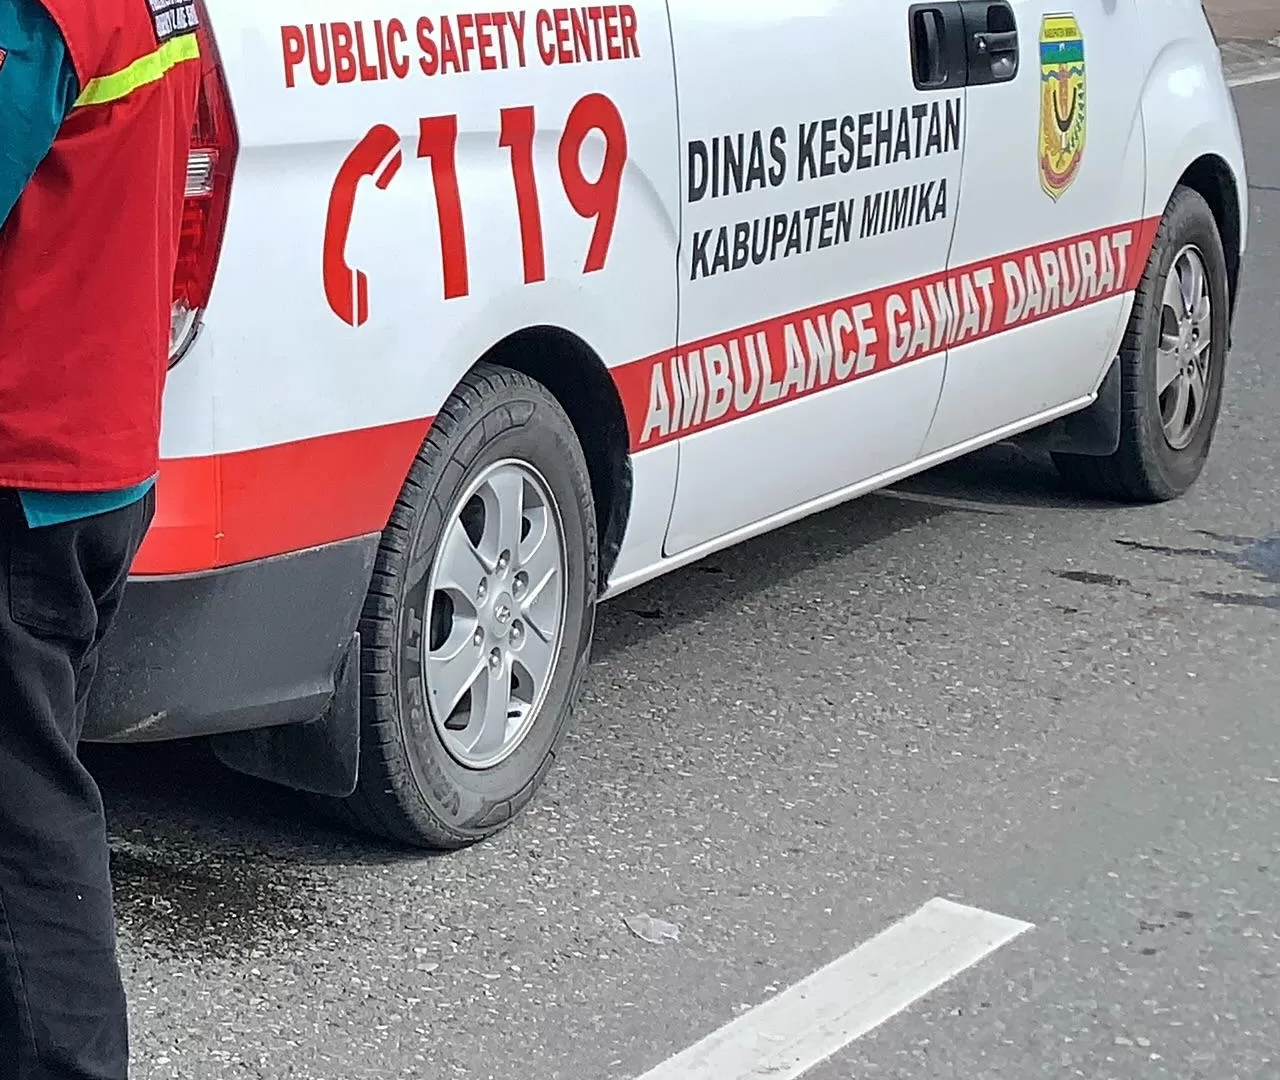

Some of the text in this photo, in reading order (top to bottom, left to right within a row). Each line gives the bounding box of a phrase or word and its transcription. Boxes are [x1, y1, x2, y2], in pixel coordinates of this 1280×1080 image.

[281, 4, 641, 88] PUBLIC SAFETY CENTER
[417, 92, 628, 301] 119
[687, 97, 962, 203] DINAS KESEHATAN
[690, 178, 948, 281] KABUPATEN MIMIKA
[639, 229, 1133, 444] AMBULANCE GAWAT DARURAT
